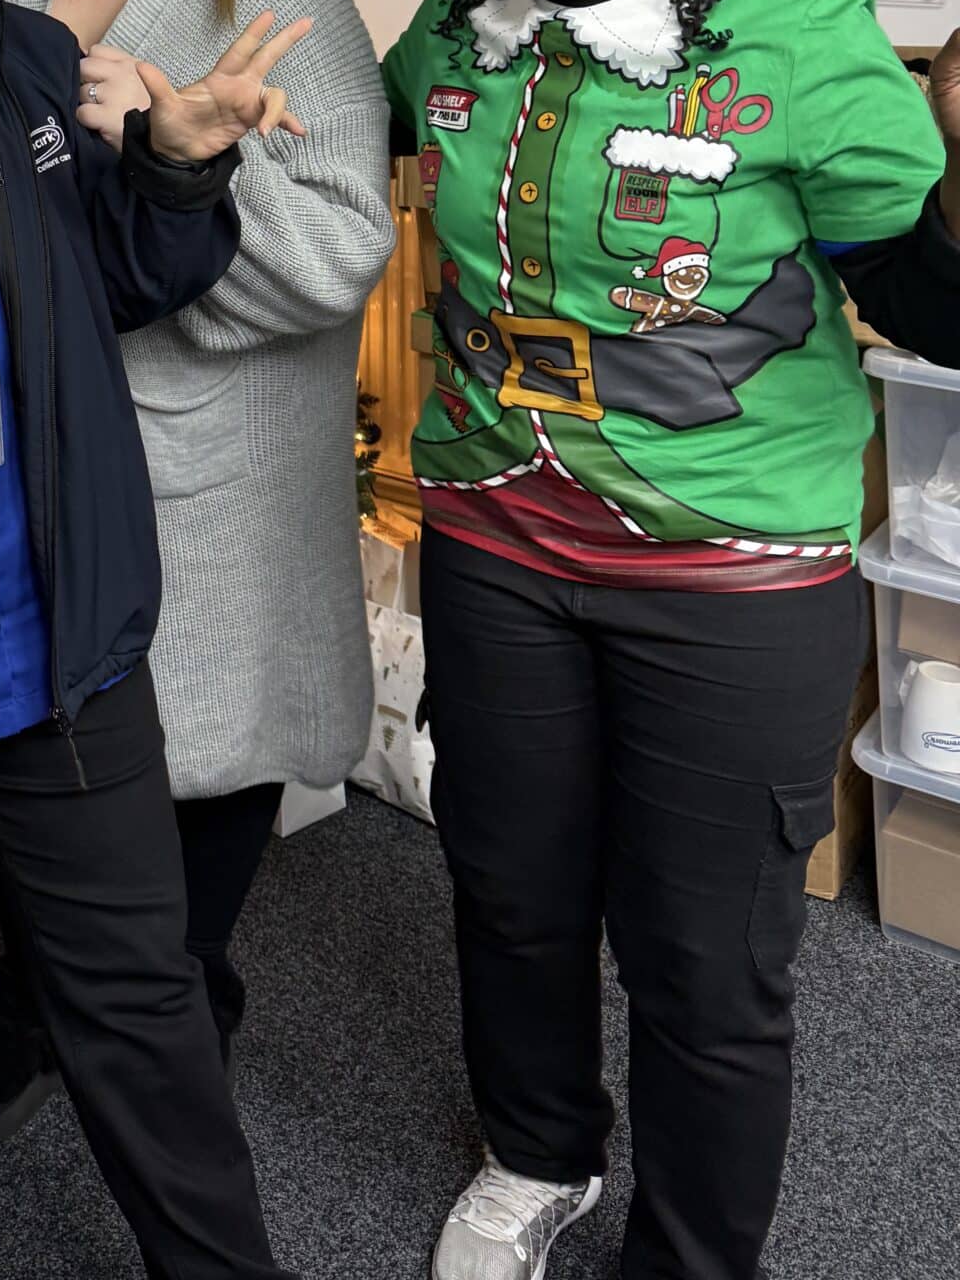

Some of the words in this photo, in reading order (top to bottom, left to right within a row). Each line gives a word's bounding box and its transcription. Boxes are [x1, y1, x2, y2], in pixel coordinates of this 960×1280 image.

[430, 94, 441, 106] NO
[442, 94, 467, 107] SHELF
[626, 175, 662, 191] RESPECT
[625, 186, 659, 199] YOUR
[624, 196, 657, 213] ELF
